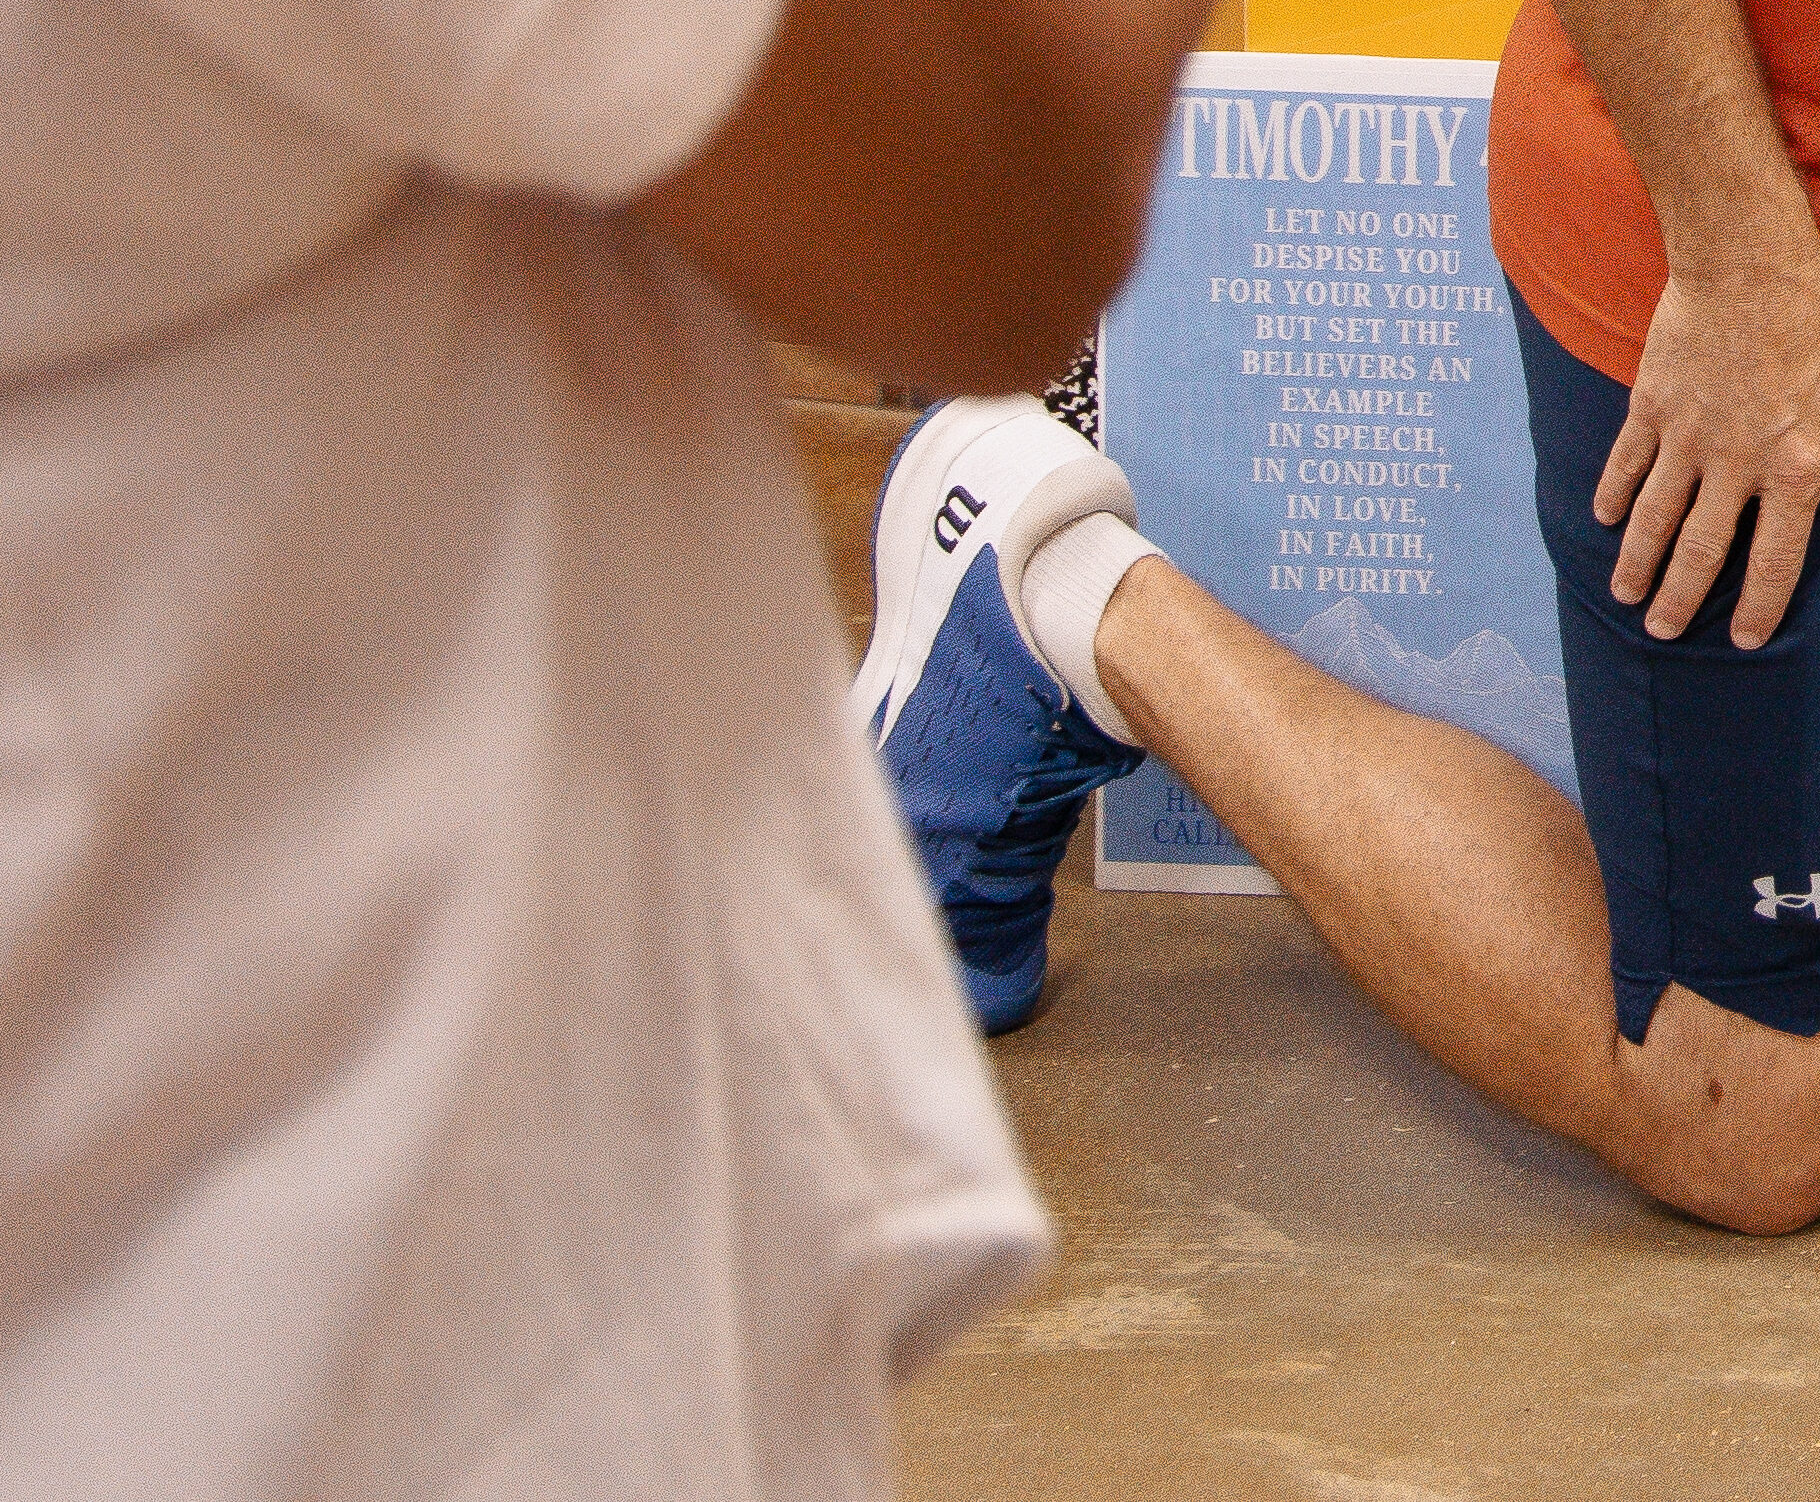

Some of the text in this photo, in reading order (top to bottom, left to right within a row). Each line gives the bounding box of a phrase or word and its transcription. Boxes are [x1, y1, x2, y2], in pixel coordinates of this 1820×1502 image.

[1177, 96, 1468, 187] TIMOTHY
[1265, 207, 1459, 239] LET NO ONE
[1253, 243, 1461, 275] DESPISE YOU
[1209, 277, 1504, 314] FOR YOUR YOUTH,
[1255, 314, 1459, 347] BUT SET THE
[1241, 350, 1473, 382] BELIEVERS AN
[1281, 387, 1433, 417] EXAMPLE
[1268, 422, 1445, 454] IN SPEECH,
[1251, 457, 1461, 491] IN CONDUCT,
[1286, 494, 1426, 525] IN LOVE,
[1279, 529, 1434, 562] IN FAITH,
[1269, 564, 1442, 595] IN PURITY.
